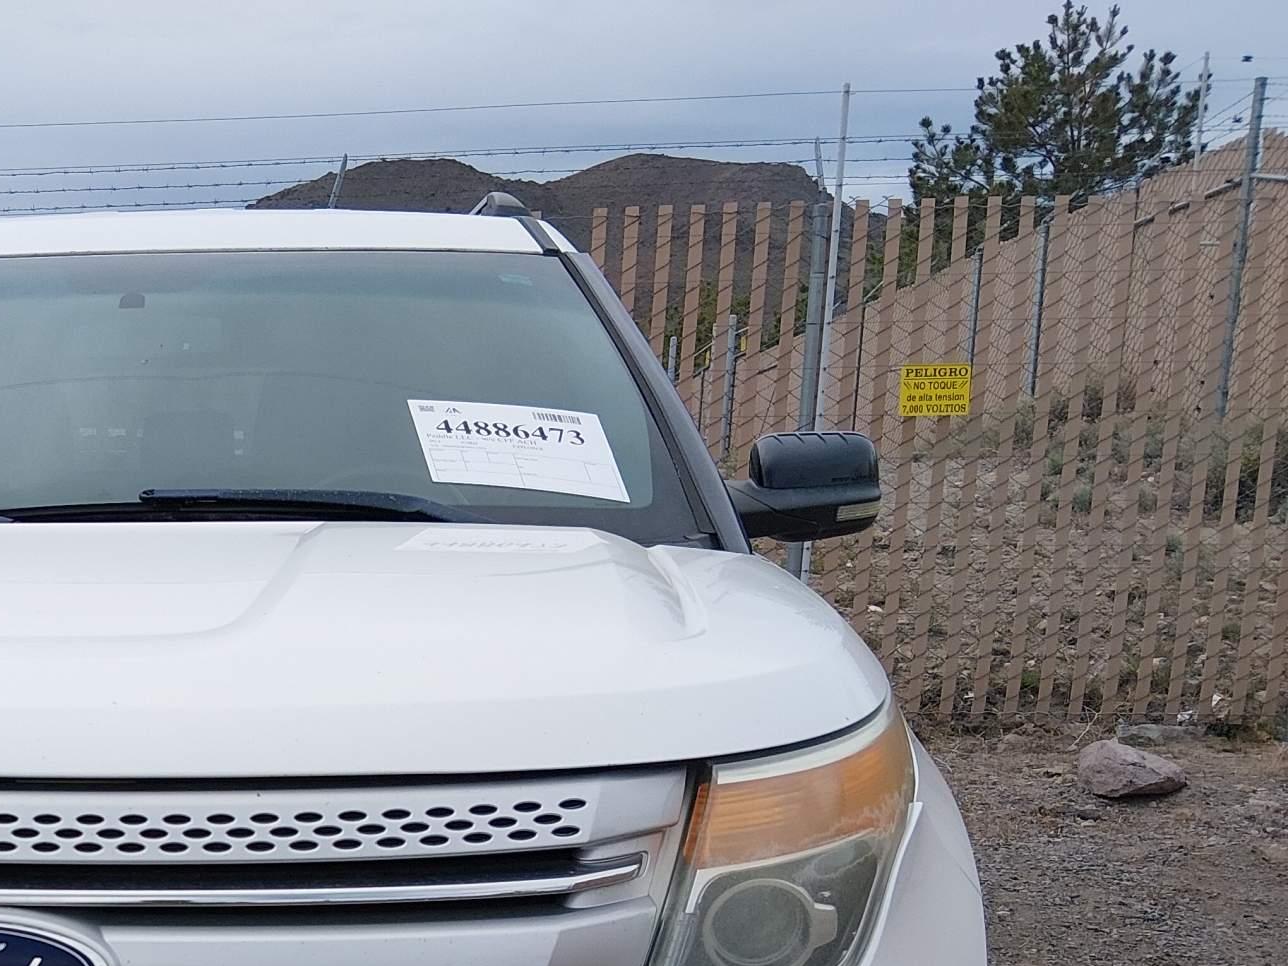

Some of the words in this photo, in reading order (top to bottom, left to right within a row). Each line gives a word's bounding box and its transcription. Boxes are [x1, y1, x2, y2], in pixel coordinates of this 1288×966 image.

[905, 367, 968, 378] PELIGRO
[913, 381, 926, 390] NO
[928, 381, 958, 390] TOQUE
[906, 393, 917, 402] de
[918, 393, 933, 402] alta
[935, 392, 965, 401] tension
[926, 403, 967, 413] VOLTIOS
[436, 419, 584, 445] 44886473
